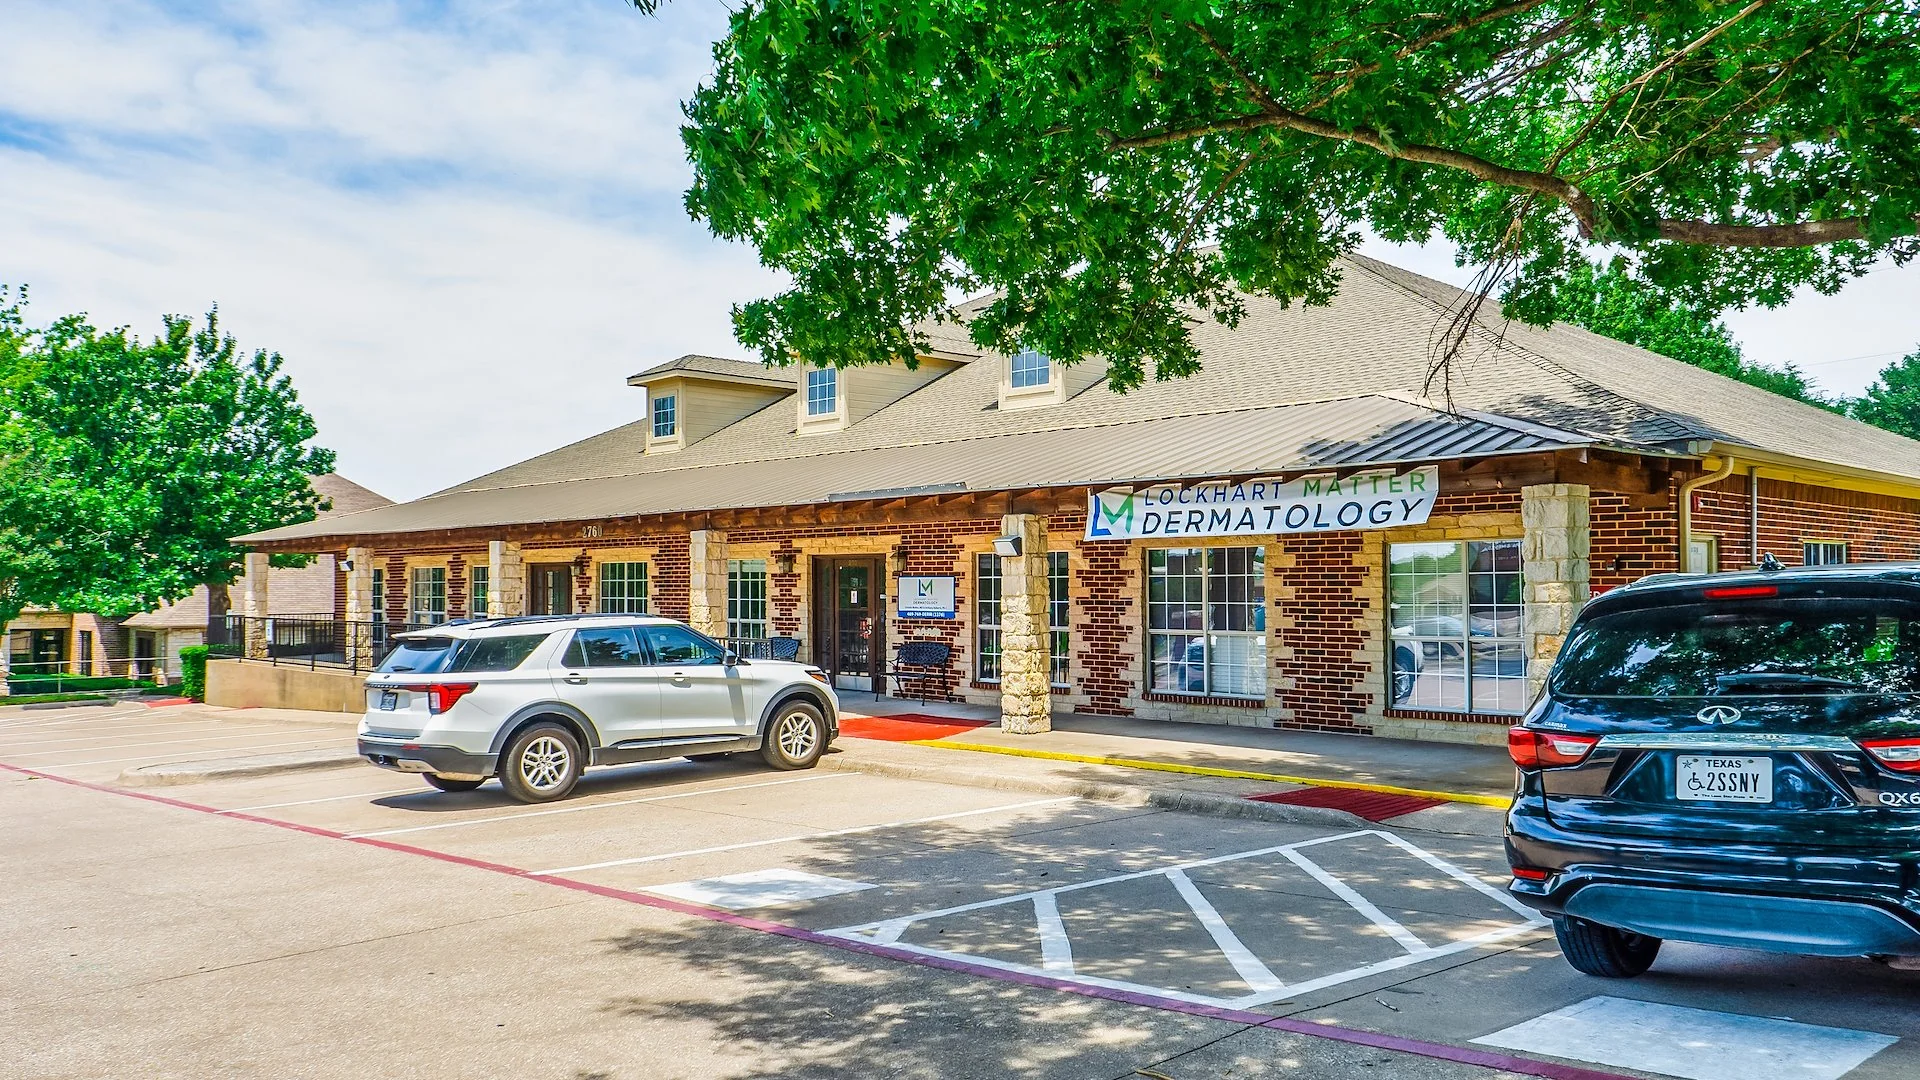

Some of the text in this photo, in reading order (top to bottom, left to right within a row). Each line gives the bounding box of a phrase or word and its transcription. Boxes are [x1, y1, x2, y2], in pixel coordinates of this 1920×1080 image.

[1144, 472, 1426, 506] LOCKHART MATTER
[1142, 498, 1425, 535] DERMATOLOGY
[582, 525, 602, 538] 2760
[1705, 759, 1742, 768] TEXAS
[1706, 772, 1759, 793] 2SSNY
